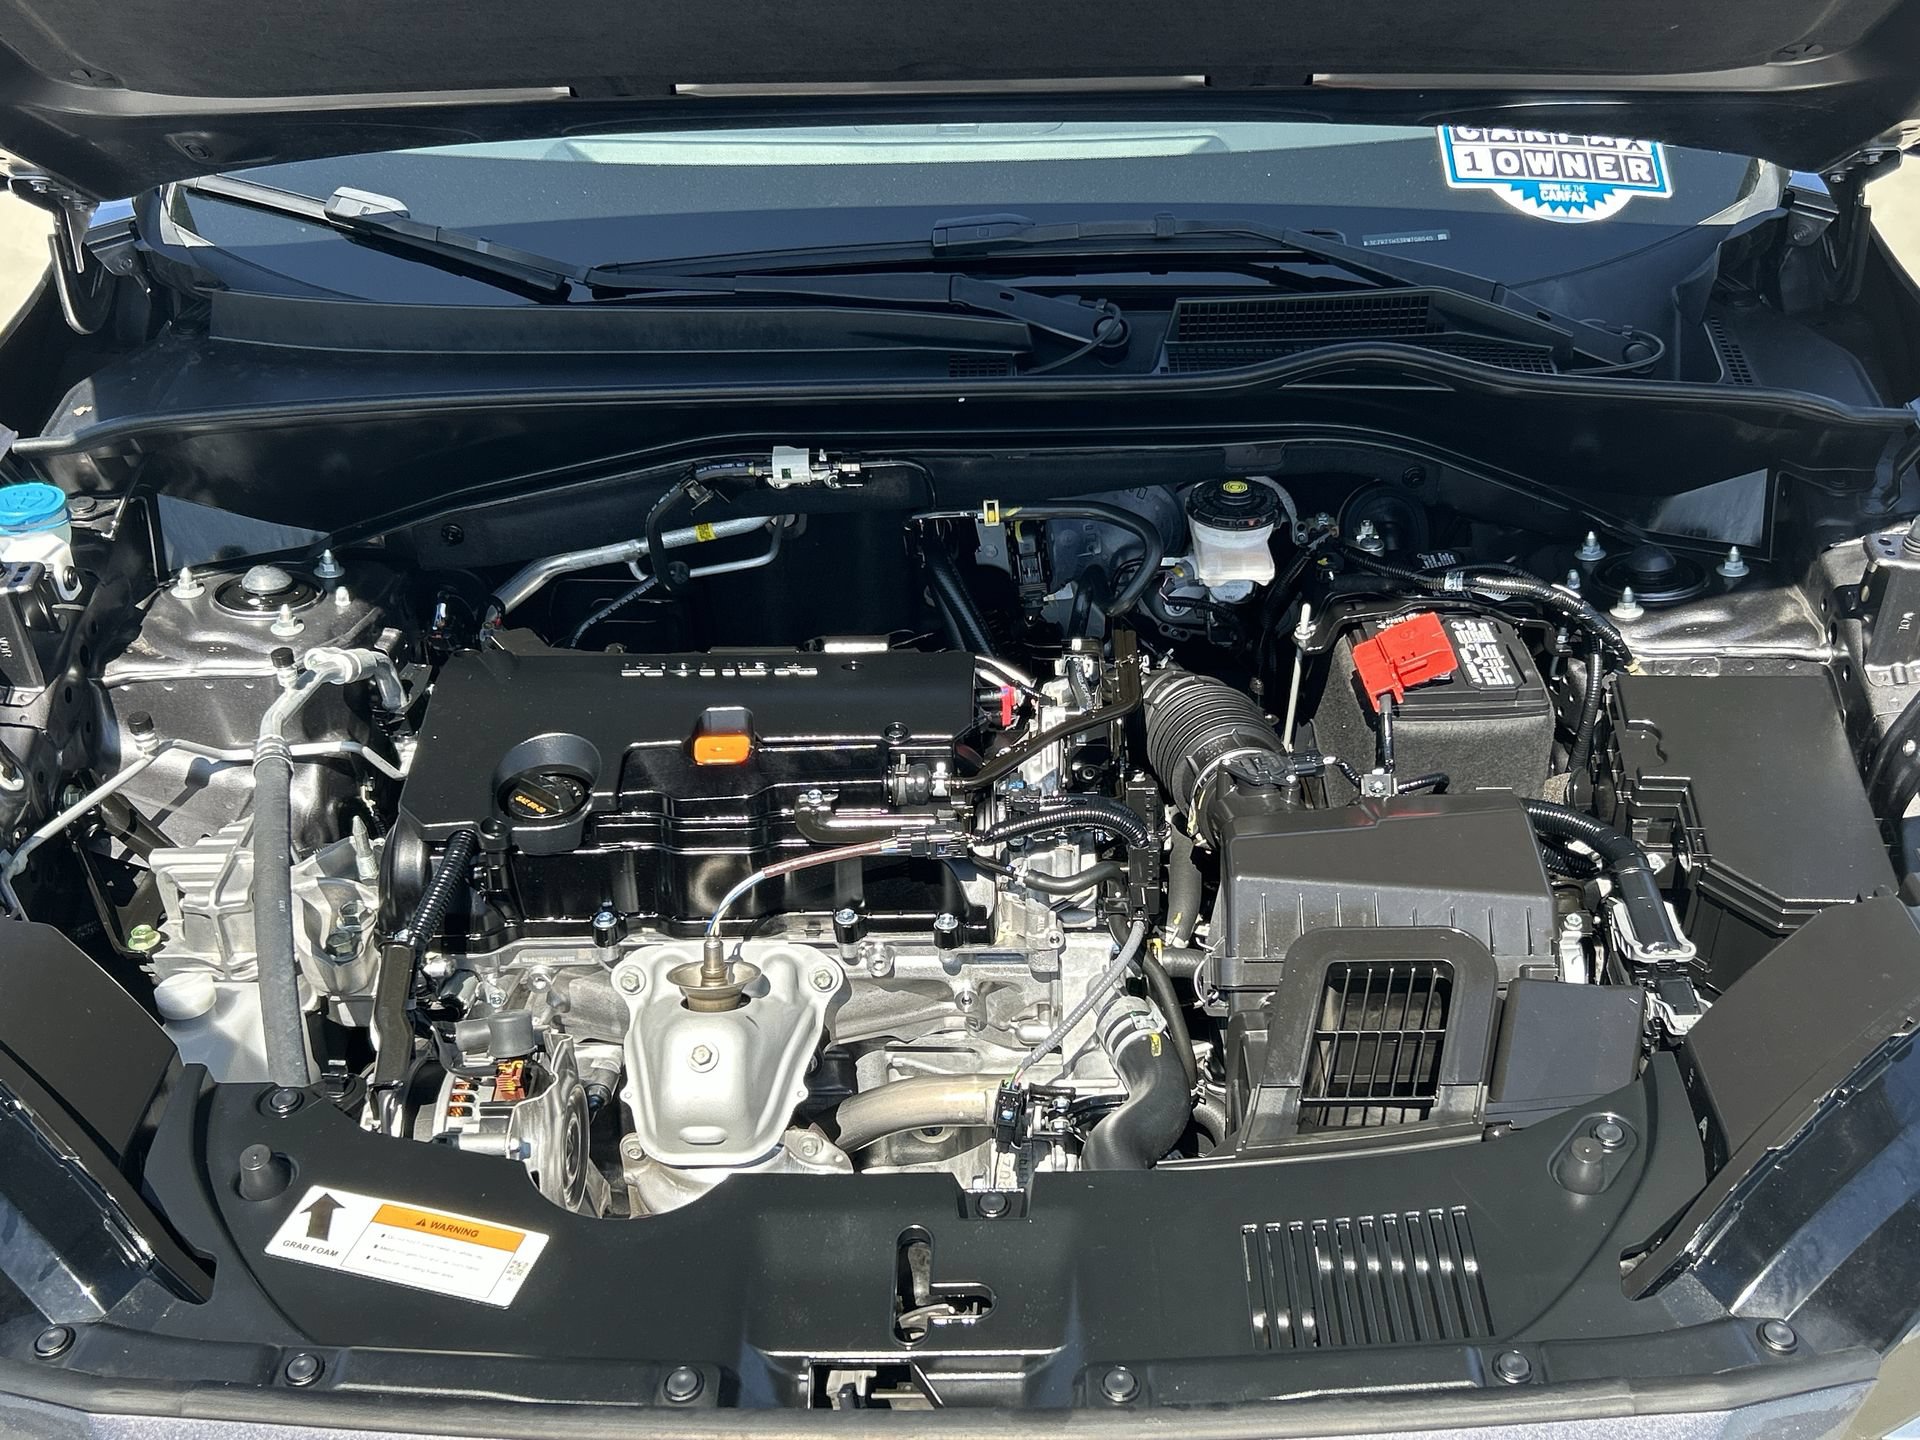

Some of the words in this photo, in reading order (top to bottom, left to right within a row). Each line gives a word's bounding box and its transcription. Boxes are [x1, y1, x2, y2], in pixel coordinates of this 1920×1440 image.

[1464, 151, 1482, 172] 1
[1495, 150, 1651, 181] OWNER
[1540, 190, 1589, 203] CARFAX
[430, 1220, 479, 1238] WARNING
[282, 1239, 309, 1252] GRAB
[310, 1245, 339, 1258] FOAM
